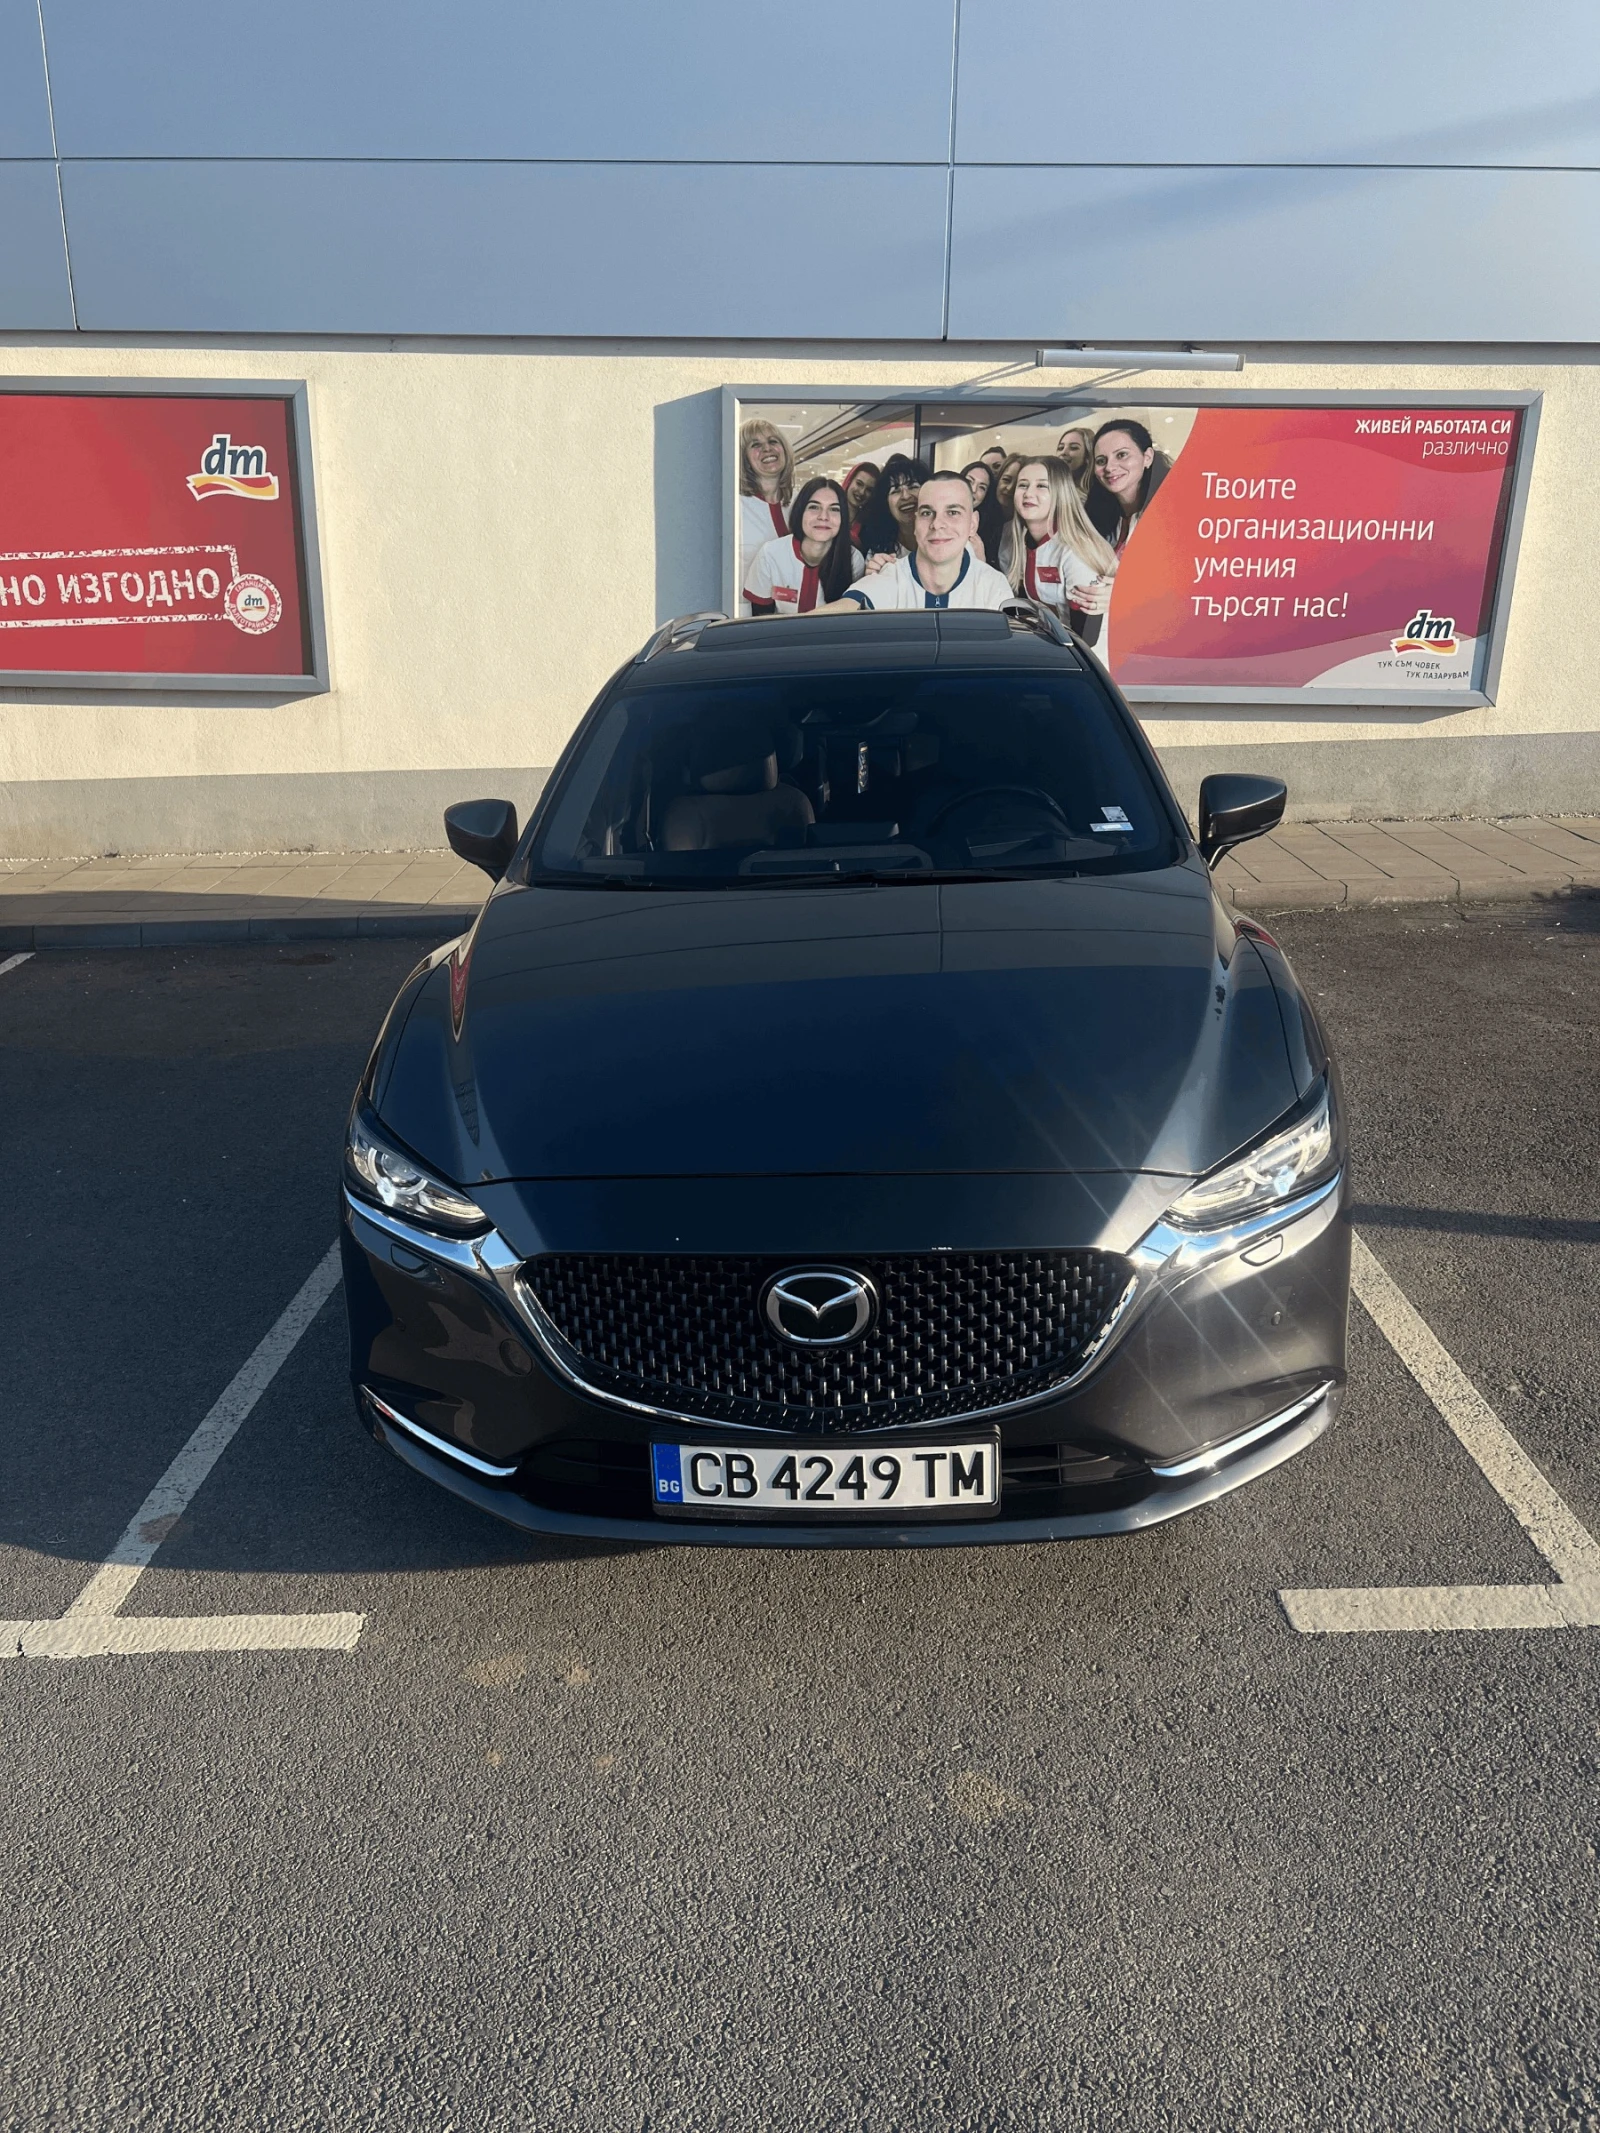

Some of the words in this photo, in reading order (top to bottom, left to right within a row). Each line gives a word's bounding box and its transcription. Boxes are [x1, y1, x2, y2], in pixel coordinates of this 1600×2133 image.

[1355, 419, 1411, 434] ЖИВЕЙ
[1415, 419, 1487, 434] РАБОТАТА
[1491, 420, 1512, 434] СИ
[205, 438, 264, 475] dm
[1422, 440, 1509, 458] различно
[1201, 472, 1297, 500] Твоите
[1198, 517, 1434, 544] организационни
[1193, 556, 1296, 583] умения
[57, 568, 220, 607] ИЗГОДНО
[235, 580, 267, 592] ГАРАНЦИЯ
[244, 595, 262, 606] dm
[1191, 595, 1284, 622] търсят
[1293, 593, 1348, 618] нас!
[1406, 612, 1452, 639] dm
[1378, 661, 1393, 669] ТУК
[1415, 662, 1441, 670] ЧОВЕК
[1406, 671, 1420, 679] ТУК
[1423, 671, 1469, 680] ПАЗАРУВАМ
[658, 1479, 680, 1494] BG
[690, 1453, 758, 1499] CB
[771, 1455, 901, 1501] 4249
[915, 1451, 985, 1498] TM
